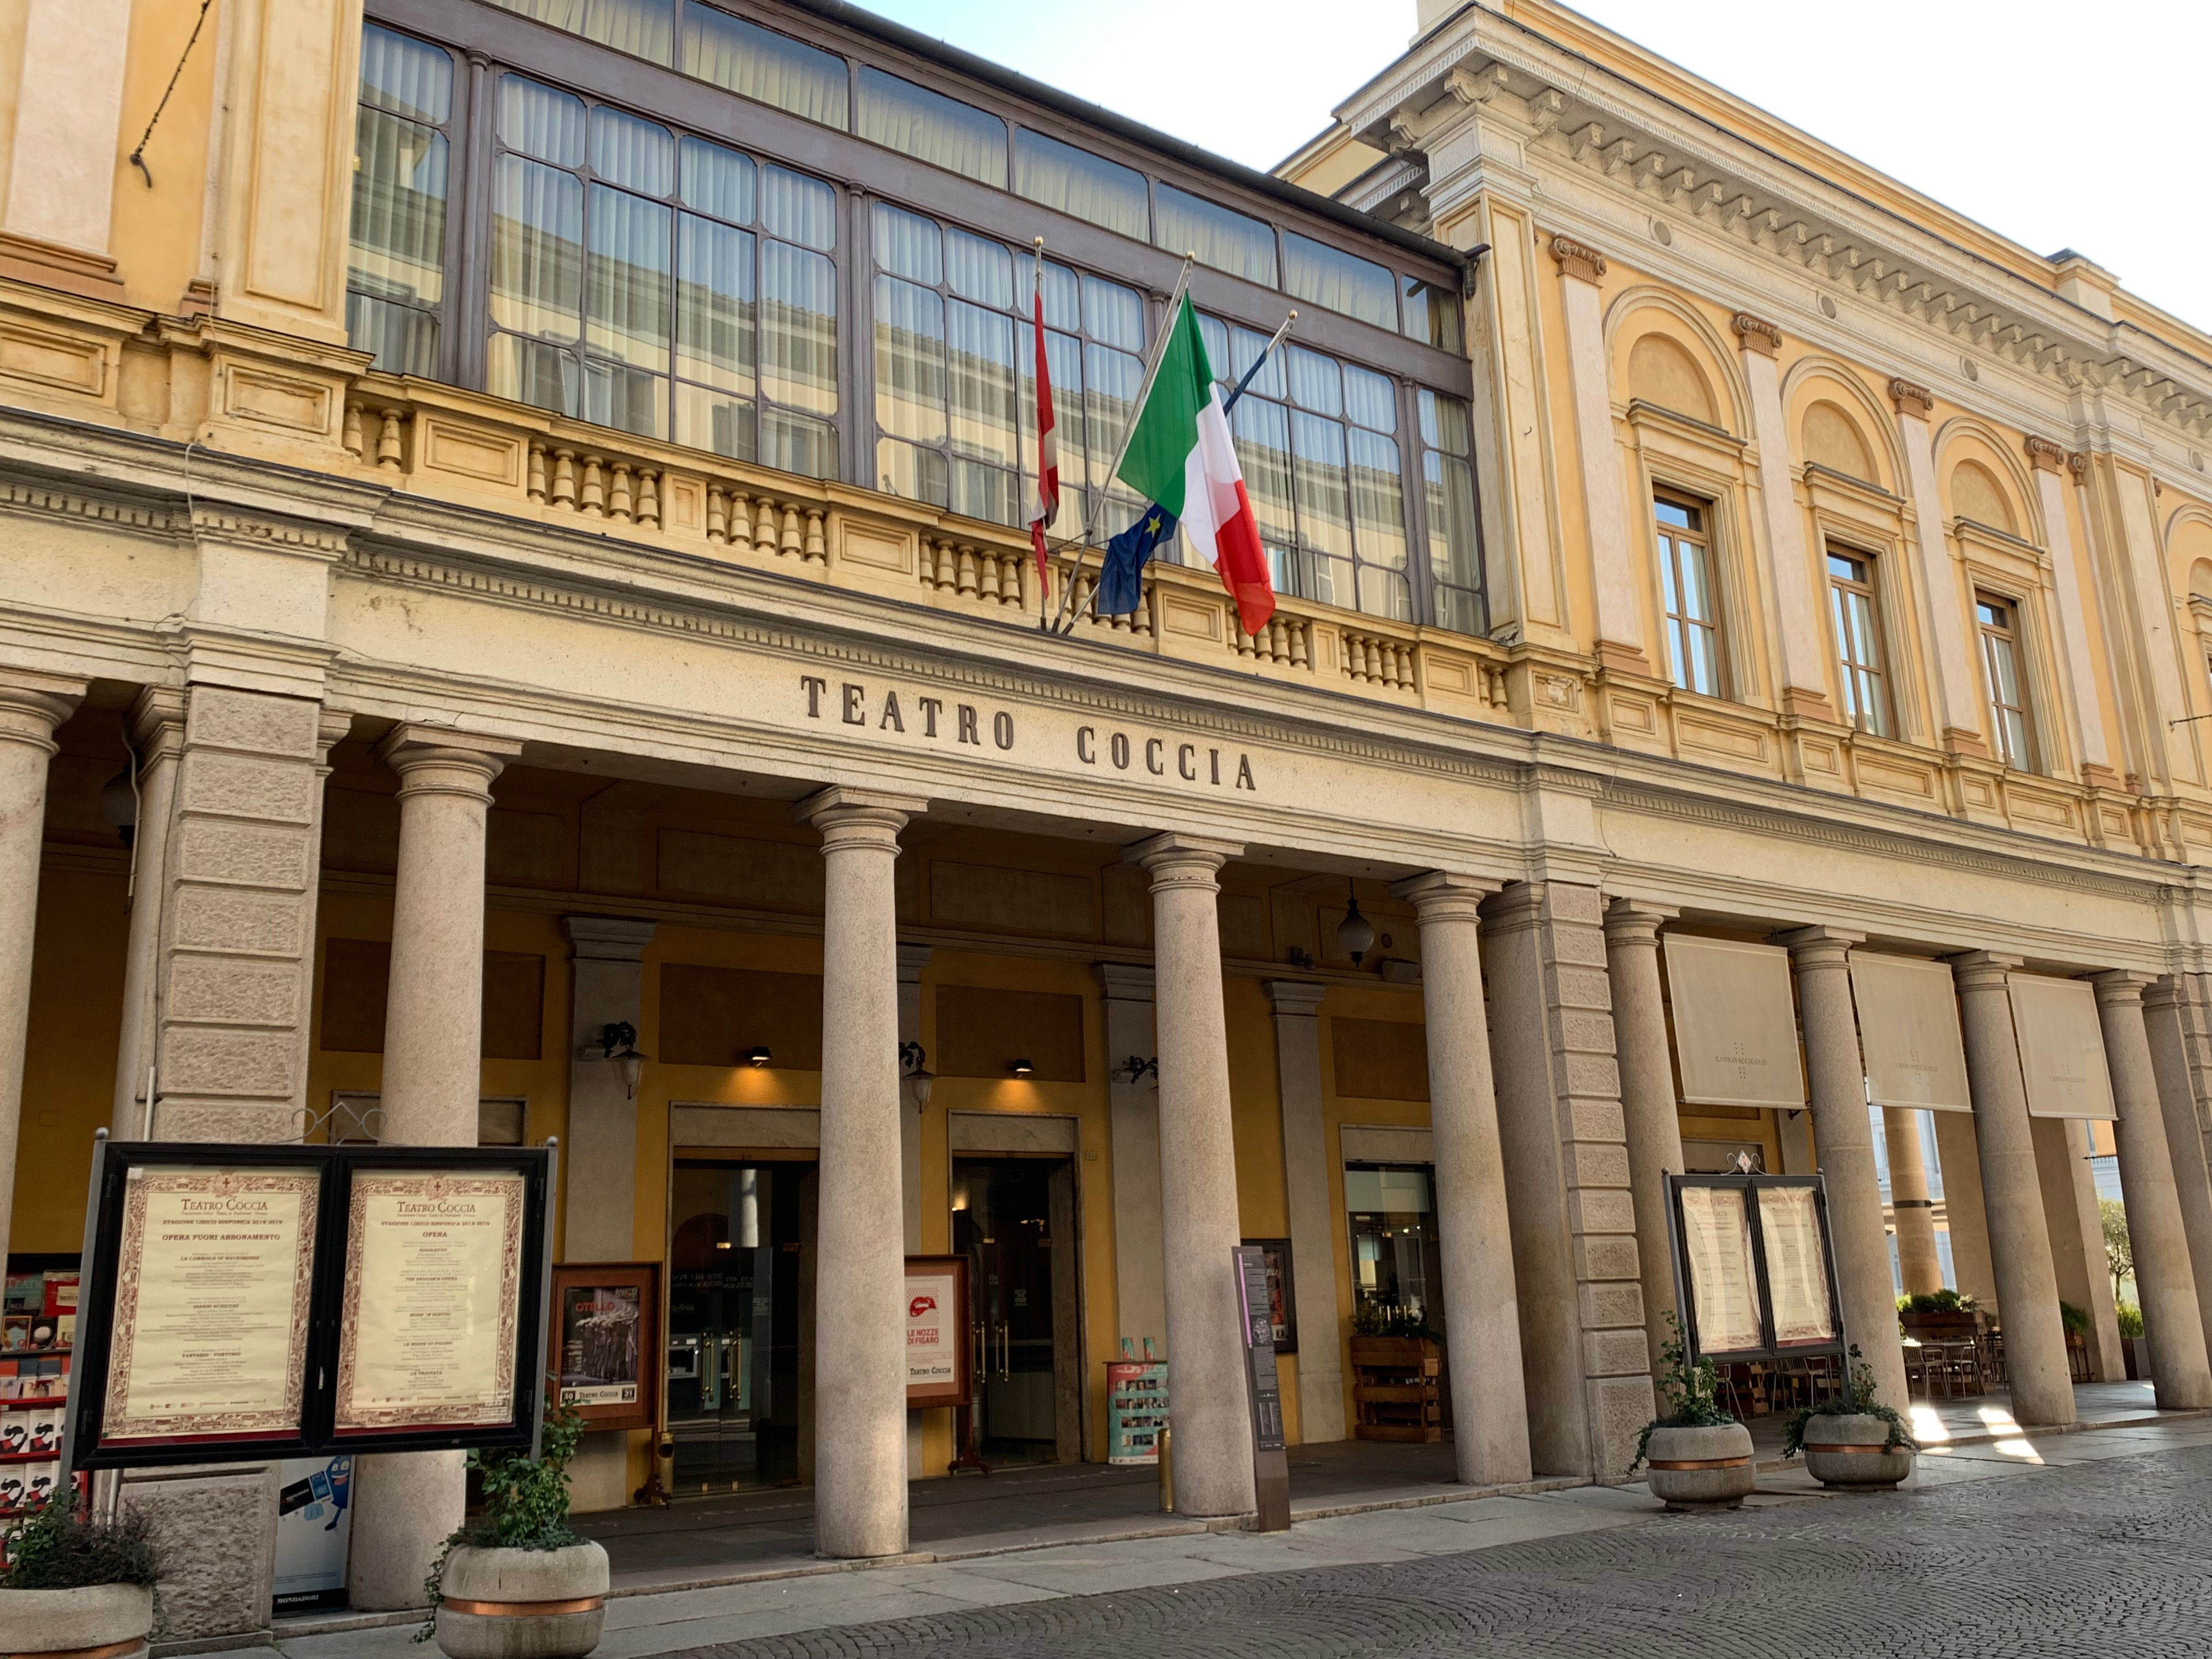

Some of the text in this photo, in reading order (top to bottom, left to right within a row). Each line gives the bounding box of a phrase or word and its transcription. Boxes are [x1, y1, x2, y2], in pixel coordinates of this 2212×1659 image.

[800, 675, 1256, 791] TEATRO COCCIA
[1715, 1056, 1766, 1065] CANNAVACCIUOLO
[180, 1198, 268, 1210] TEATRO COCCIA
[397, 1201, 475, 1212] TEATRO COCCIA
[575, 1301, 614, 1311] OTELLO
[276, 1594, 319, 1604] MONDADORI
